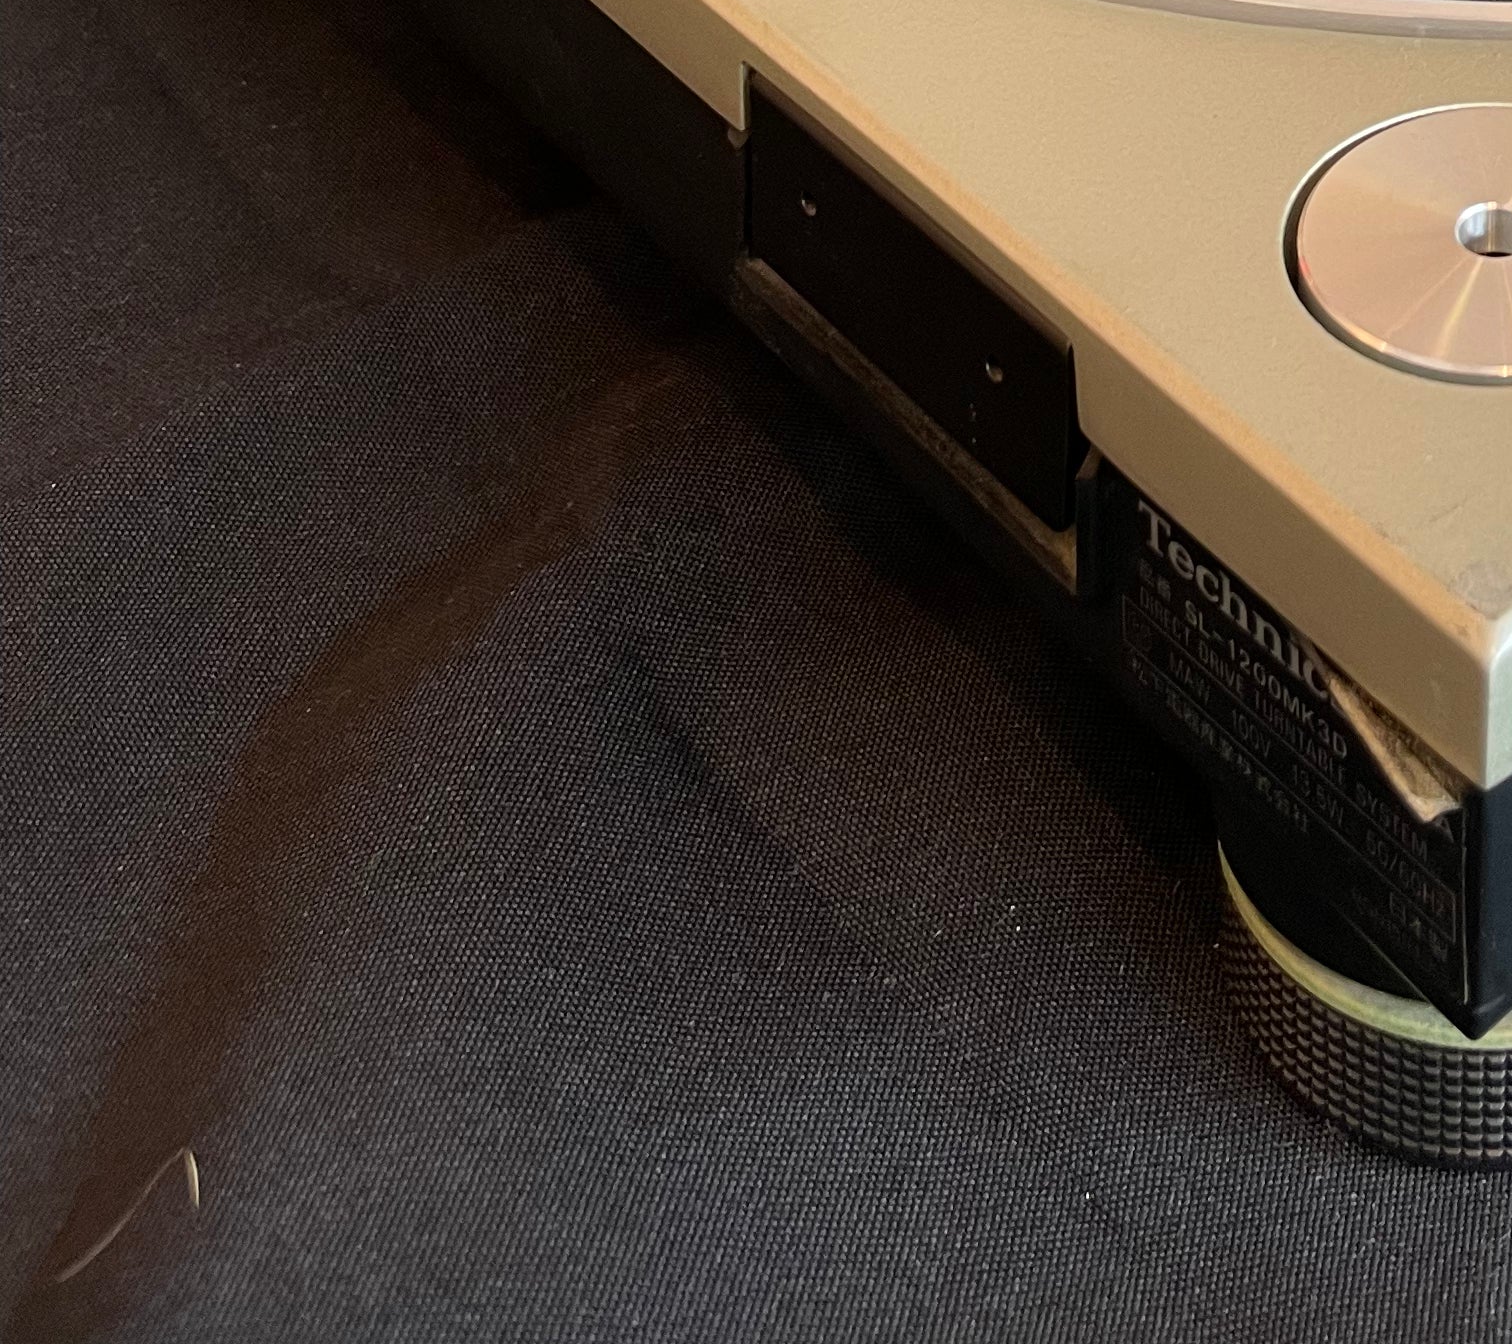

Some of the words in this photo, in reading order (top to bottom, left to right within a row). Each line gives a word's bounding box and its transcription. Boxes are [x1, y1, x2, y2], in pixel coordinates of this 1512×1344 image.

[1137, 497, 1348, 719] Technic
[1184, 596, 1348, 764] SL-1200MK3D
[1139, 586, 1190, 652] DIRECT
[1198, 640, 1244, 700] DRIVE
[1254, 689, 1344, 790] TURNTABLE
[1356, 781, 1427, 864] SYSTEM
